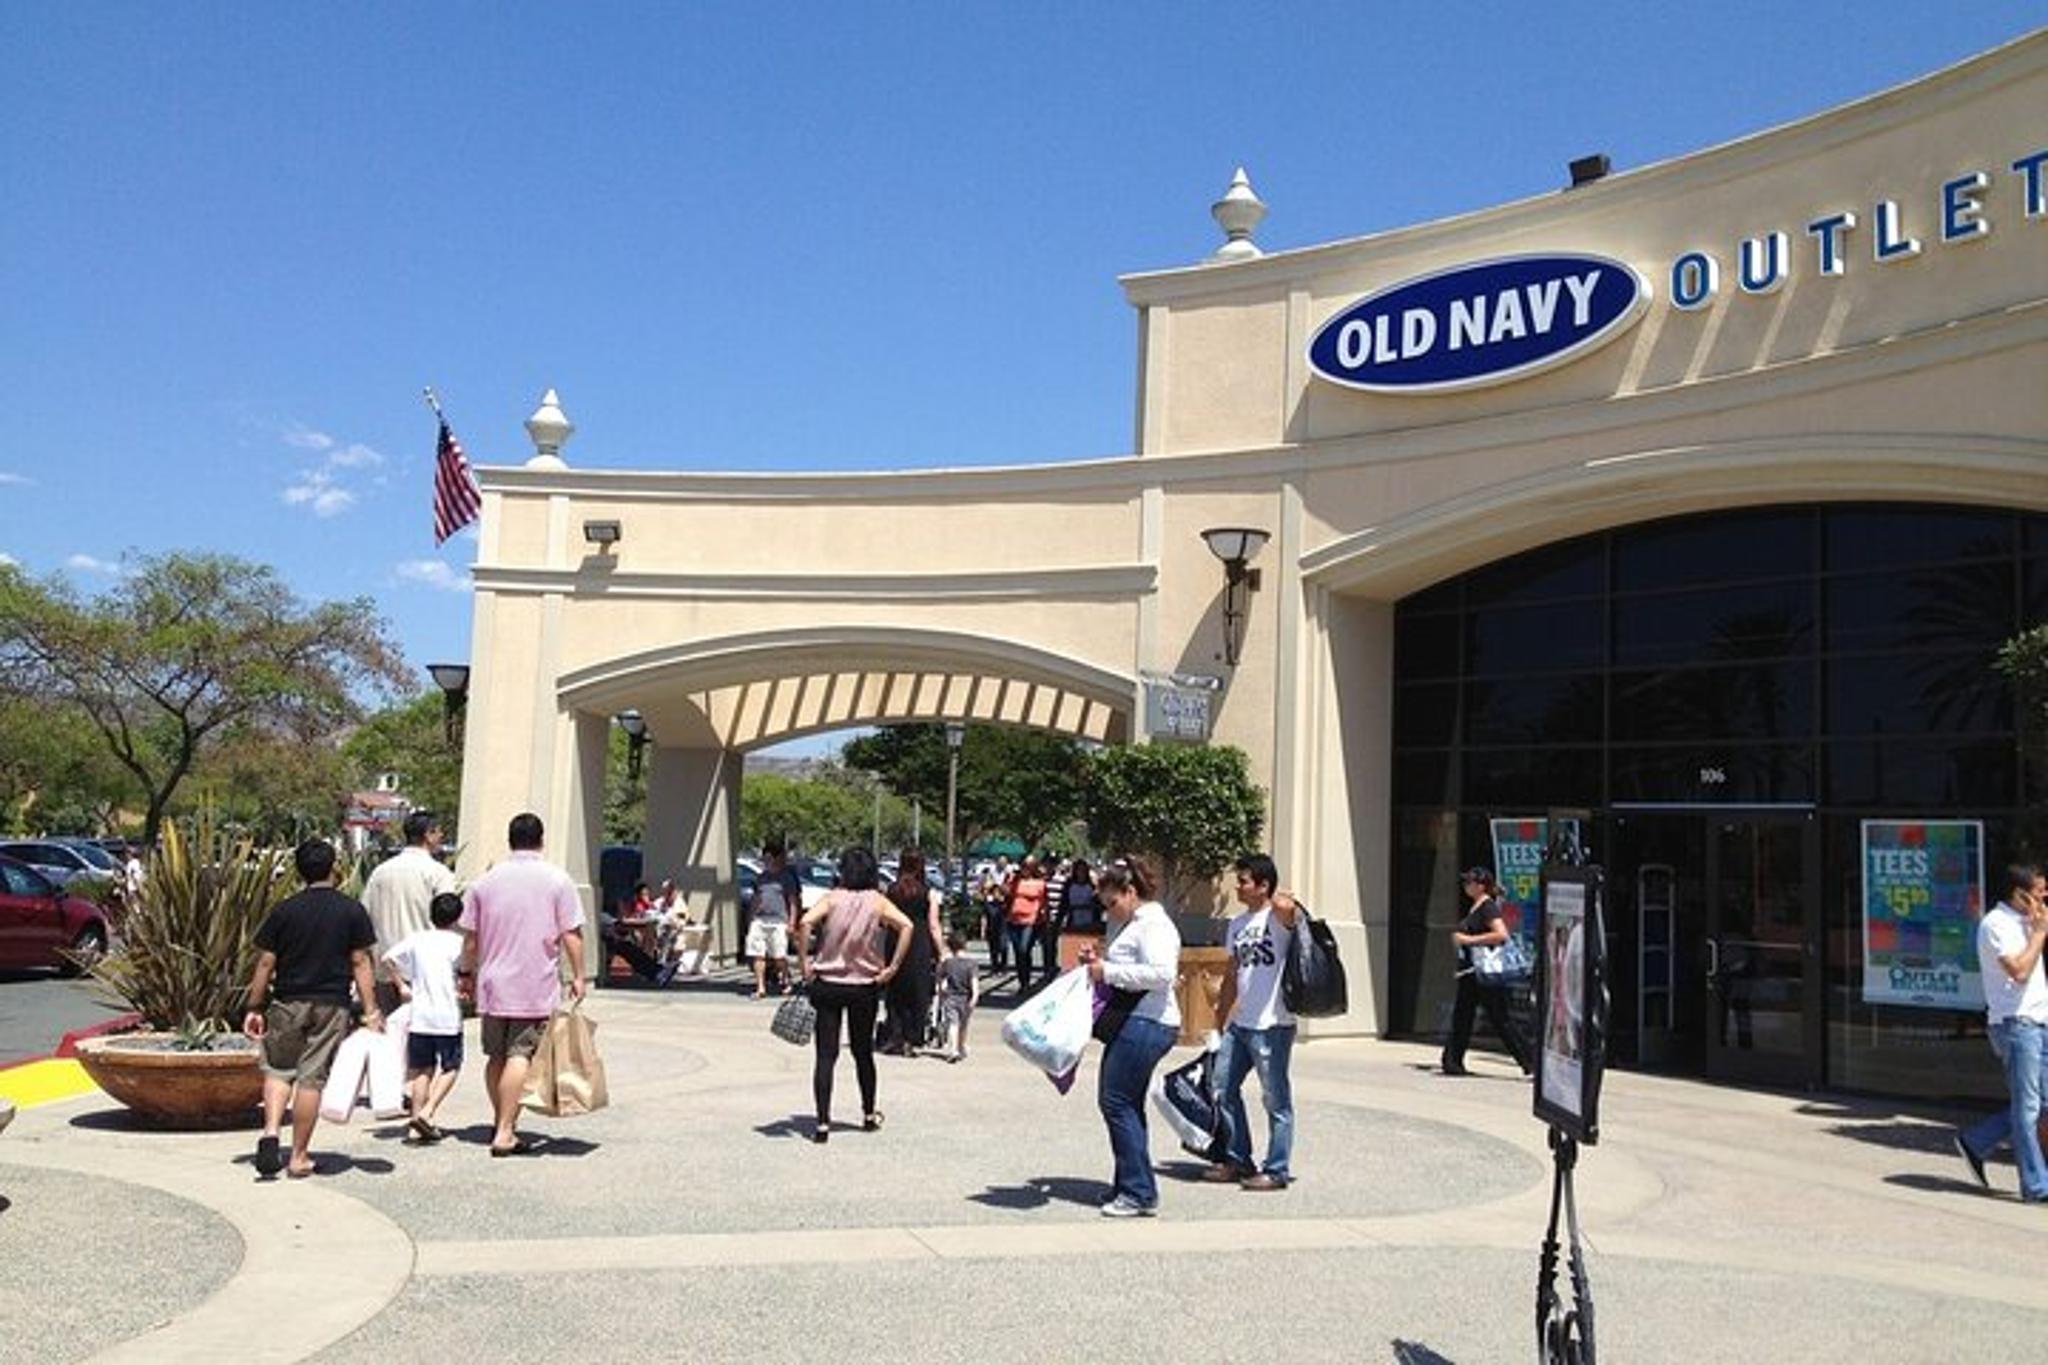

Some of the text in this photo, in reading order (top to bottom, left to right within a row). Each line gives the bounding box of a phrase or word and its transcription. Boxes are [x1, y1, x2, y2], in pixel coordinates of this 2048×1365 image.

[1670, 151, 2048, 311] OUTLET
[1336, 269, 1604, 370] OLD NAVY
[1700, 766, 1719, 780] 106
[1501, 844, 1543, 866] TEES
[1871, 849, 1928, 876] TEES
